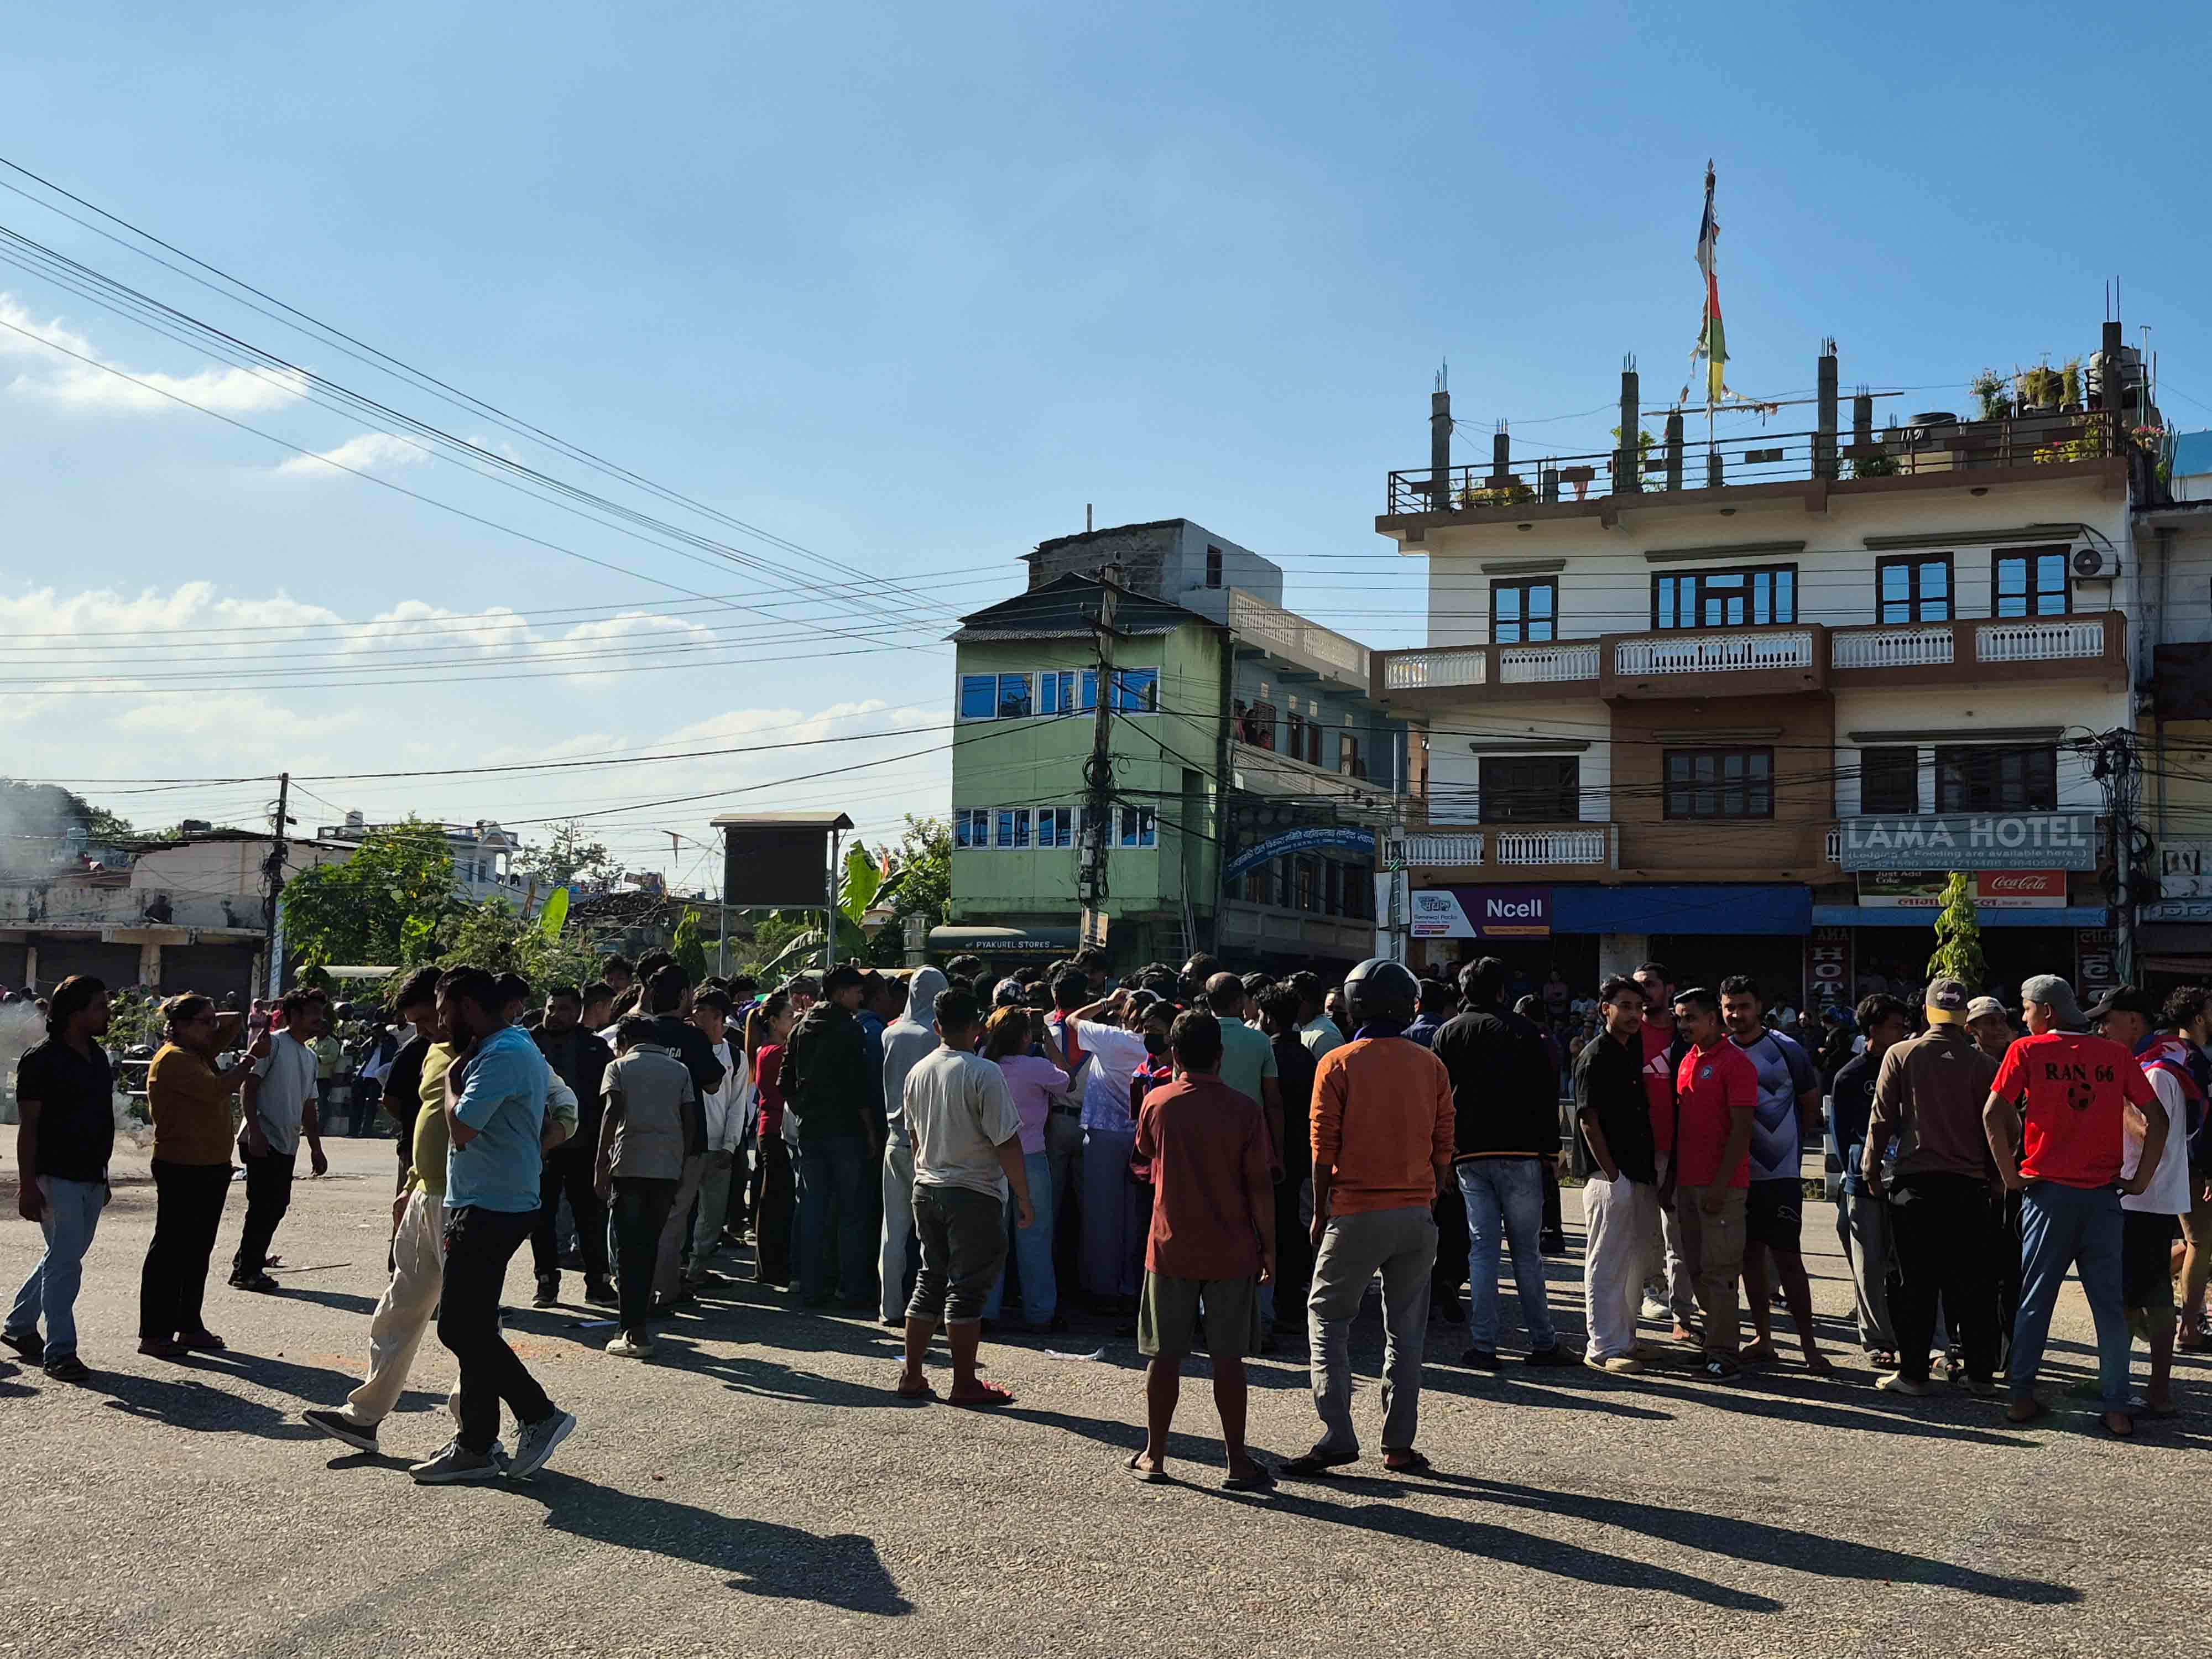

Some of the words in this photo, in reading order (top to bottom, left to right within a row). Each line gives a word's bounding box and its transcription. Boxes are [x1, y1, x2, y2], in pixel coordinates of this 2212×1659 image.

[1848, 817, 1956, 849] LAMA
[1969, 815, 2087, 848] HOTEL
[1988, 849, 2043, 858] available
[1486, 898, 1542, 918] Ncell
[2045, 1063, 2086, 1081] RAN
[2095, 1065, 2115, 1082] 66
